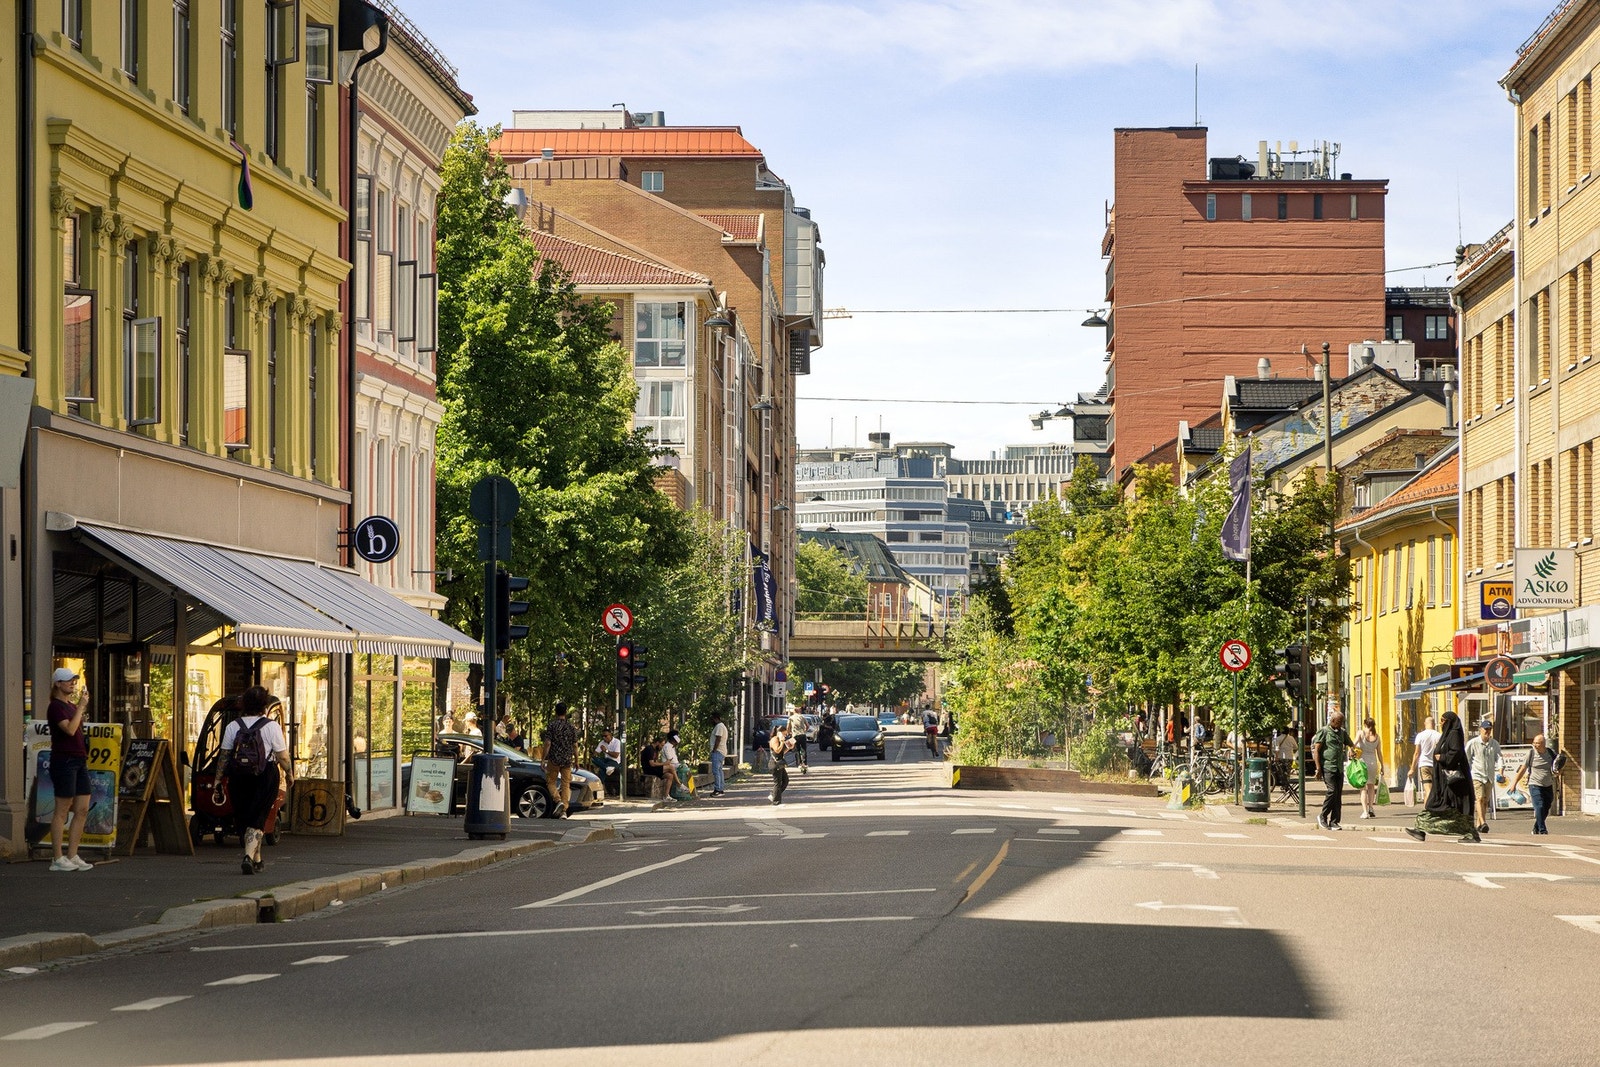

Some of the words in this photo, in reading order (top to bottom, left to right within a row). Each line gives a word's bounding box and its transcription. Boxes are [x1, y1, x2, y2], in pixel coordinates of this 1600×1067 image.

[1488, 587, 1512, 596] ATM
[1524, 578, 1568, 596] ASKØ
[34, 723, 52, 736] VÆ
